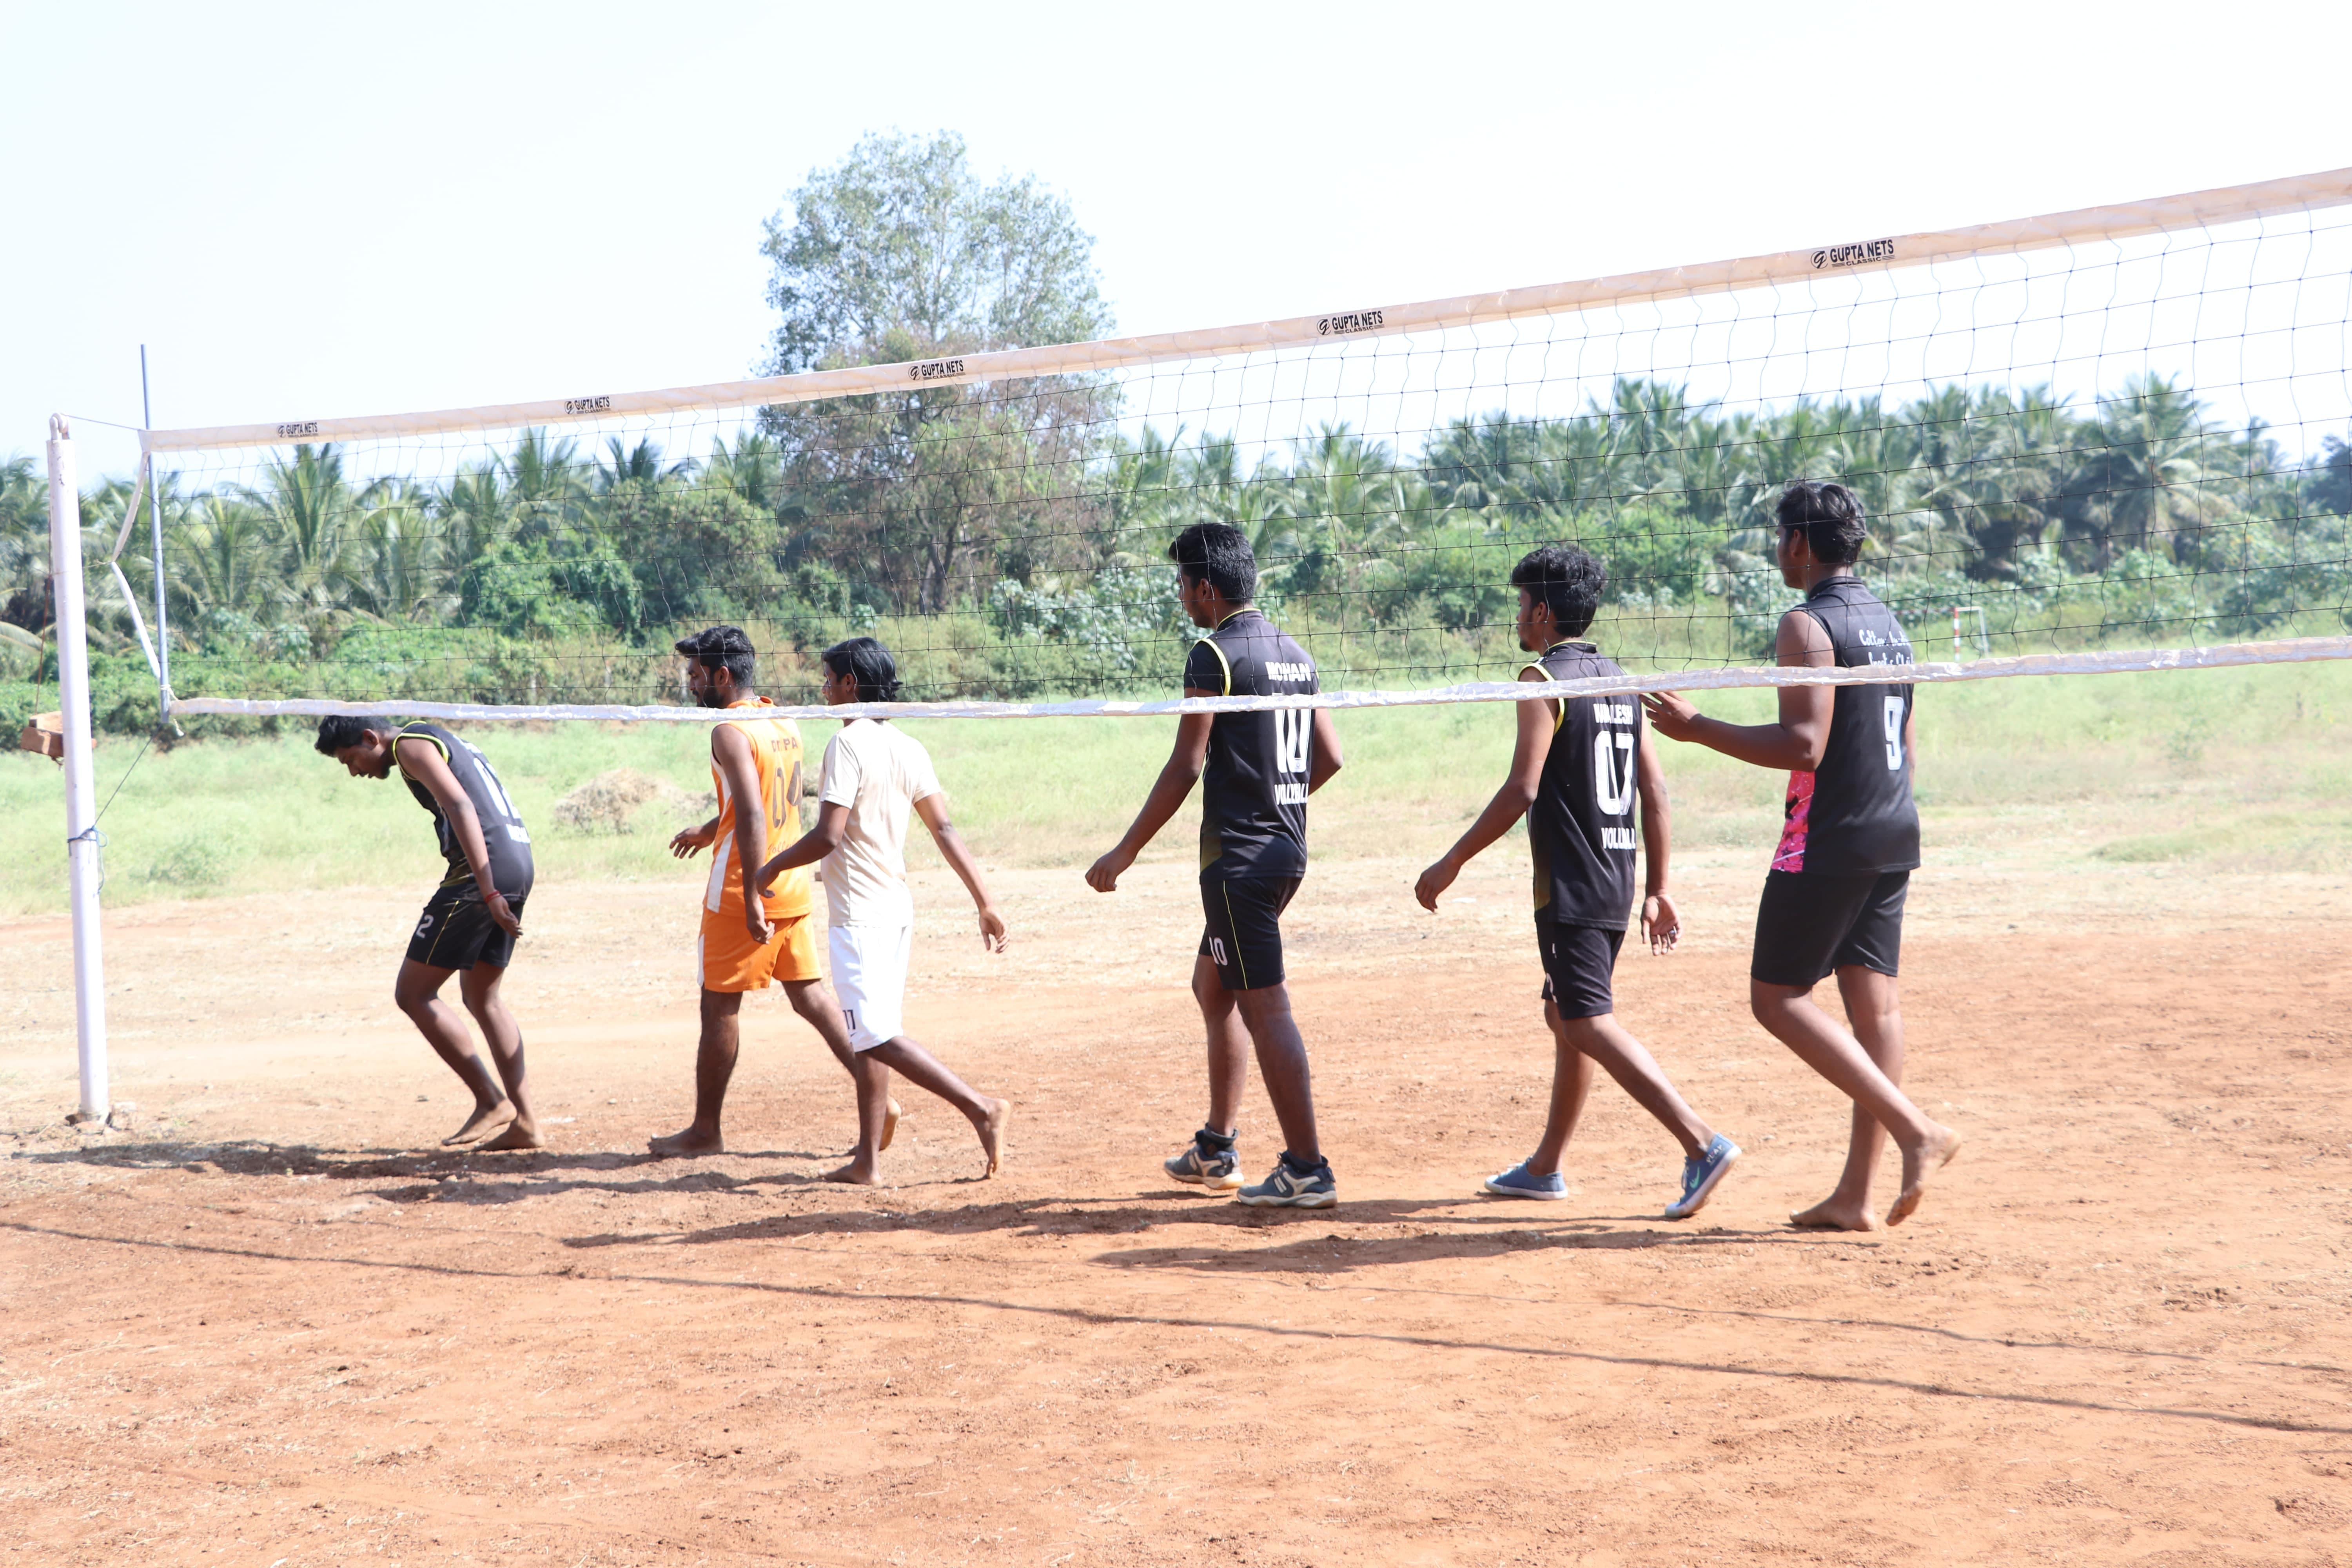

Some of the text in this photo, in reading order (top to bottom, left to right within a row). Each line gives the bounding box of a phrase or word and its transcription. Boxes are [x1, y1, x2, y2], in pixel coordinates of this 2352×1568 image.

[1830, 244, 1865, 263] GUPTA
[1867, 239, 1894, 257] NETS
[1846, 257, 1881, 266] CLASSIC
[1332, 314, 1361, 330] GUPTA
[1361, 310, 1383, 326] NETS
[921, 363, 944, 376] GUPTA
[946, 359, 964, 373] NETS
[574, 399, 593, 410] GUPTA
[595, 396, 610, 408] NETS
[286, 423, 303, 434] GUPTA
[305, 422, 318, 433] NETS
[1265, 661, 1311, 682] MOHAN
[1884, 696, 1904, 770] 9
[1594, 731, 1634, 815] 07
[772, 761, 802, 829] 04
[416, 914, 434, 938] 2
